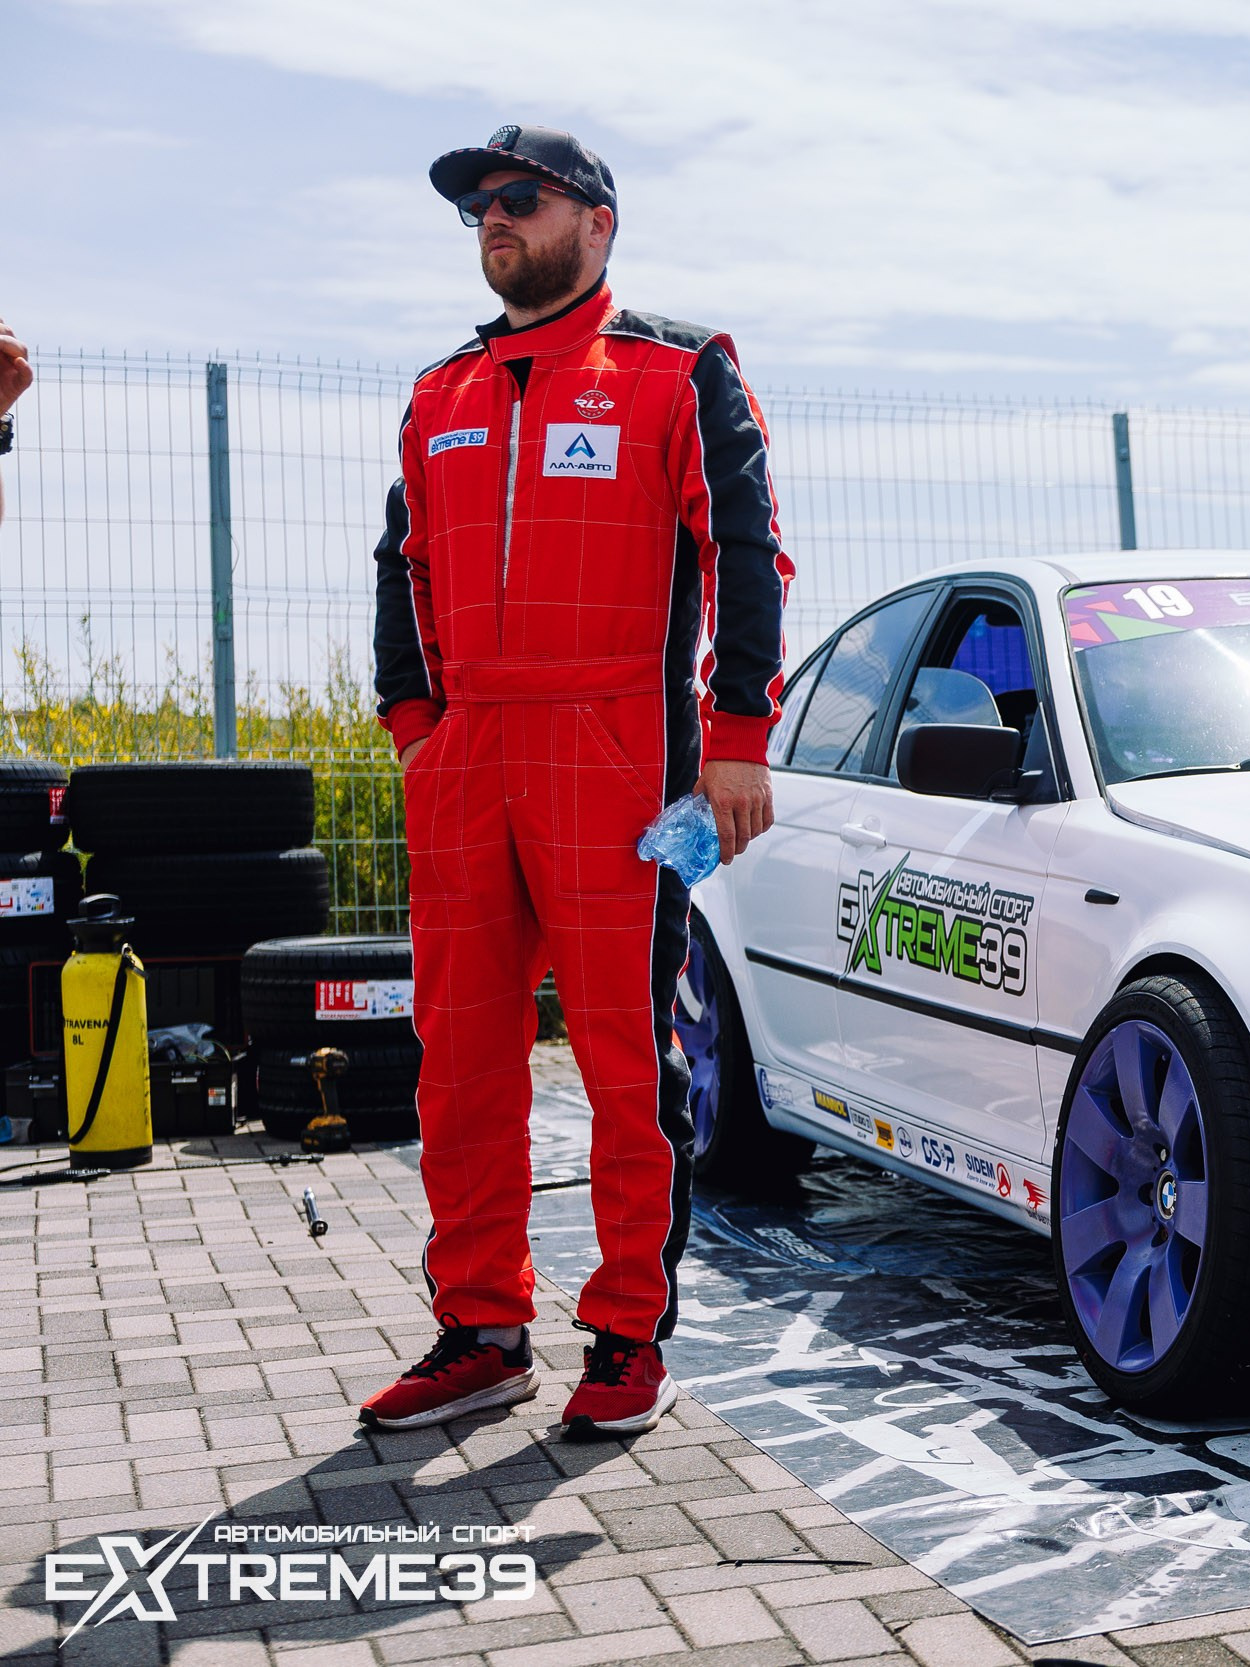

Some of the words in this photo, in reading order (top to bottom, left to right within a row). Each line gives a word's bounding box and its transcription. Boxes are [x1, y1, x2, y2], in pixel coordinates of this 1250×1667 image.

[575, 398, 616, 410] RLG
[470, 432, 484, 443] 39
[549, 462, 612, 472] ЛАЛ-АВТО
[1122, 584, 1194, 620] 19
[896, 868, 991, 916] АВТОМОБИЛЬНЫЙ
[989, 889, 1035, 926] СПОРТ
[837, 851, 1028, 996] EXTREME39
[72, 1034, 84, 1045] 8L
[965, 1153, 996, 1180] SIDEM
